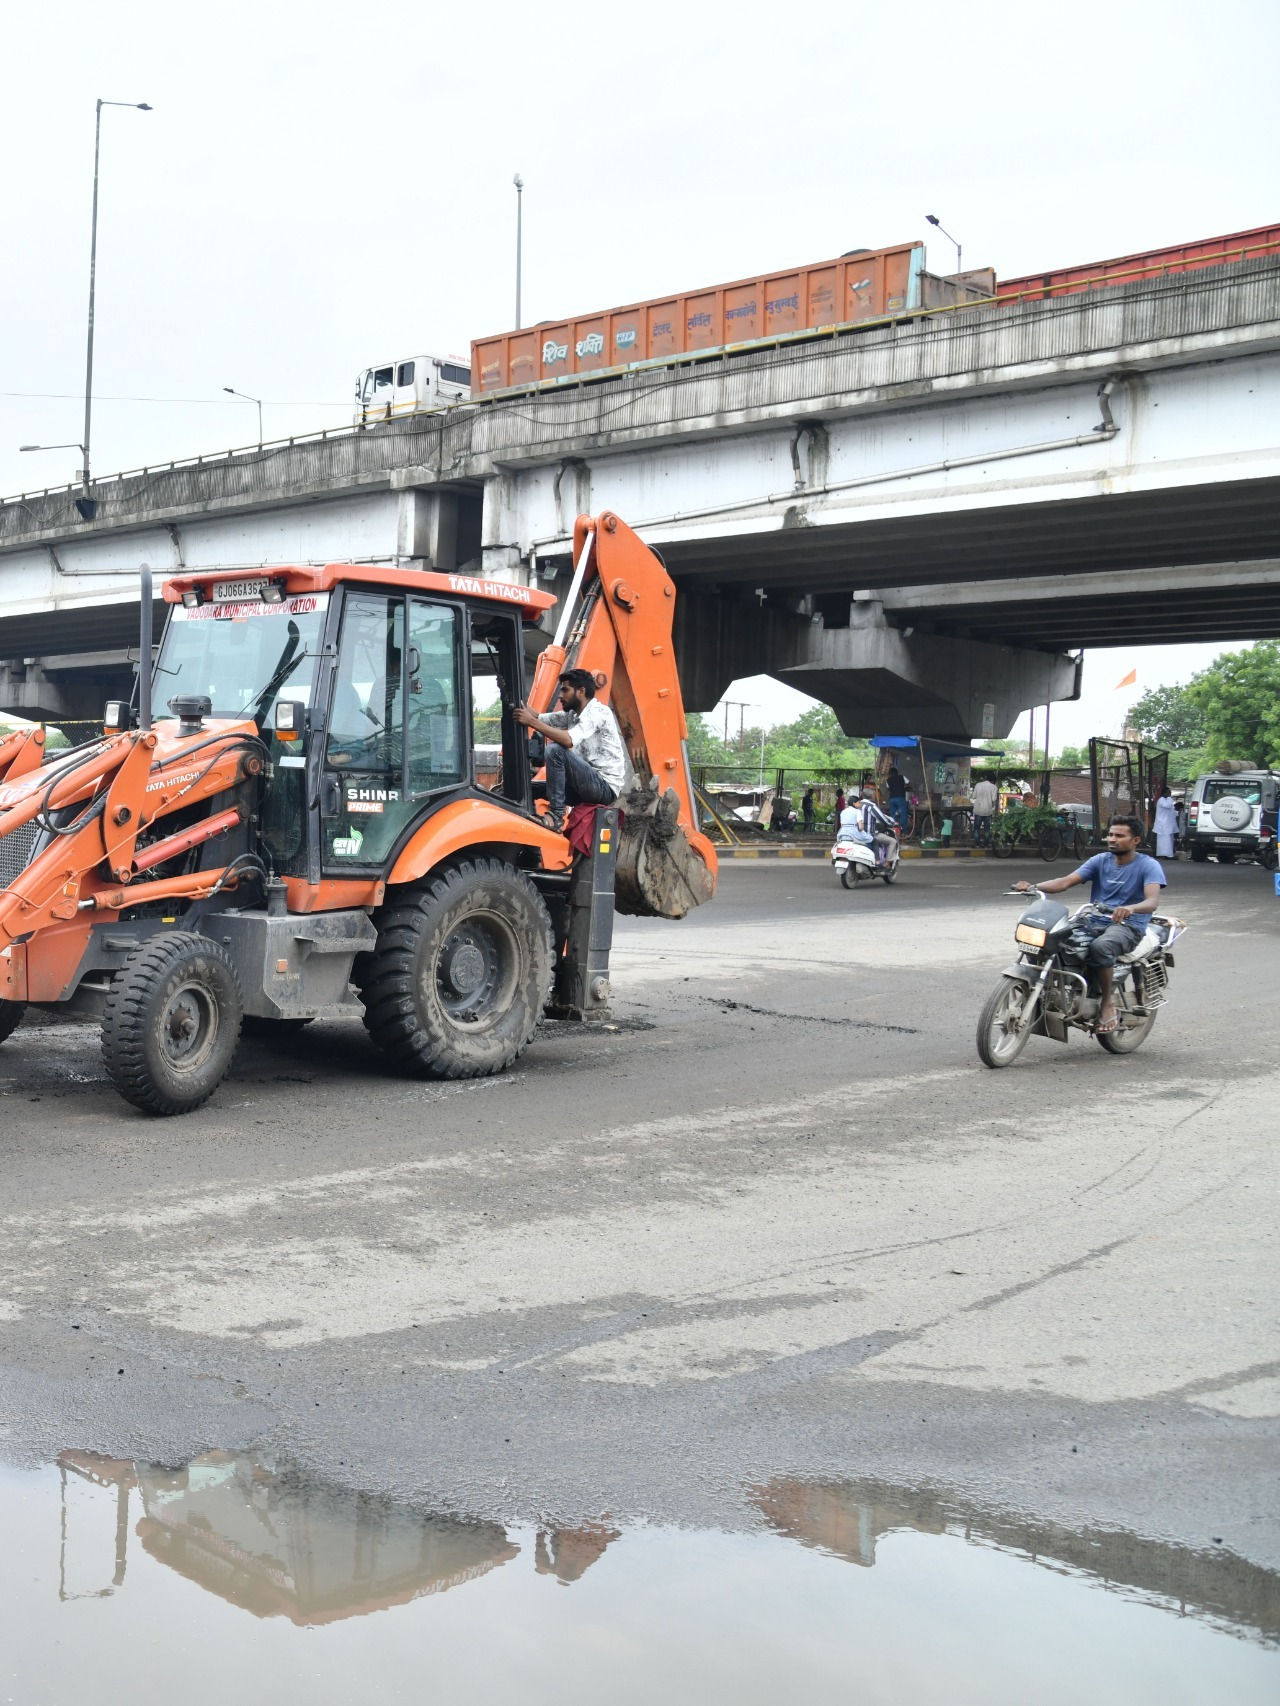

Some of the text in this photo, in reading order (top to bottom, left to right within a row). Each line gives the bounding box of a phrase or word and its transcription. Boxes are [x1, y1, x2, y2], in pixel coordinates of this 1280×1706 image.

[448, 577, 530, 603] TATA HITACHI
[186, 597, 317, 620] VADODARA MUNICIPAL CORPORATION
[348, 803, 382, 812] PRIME
